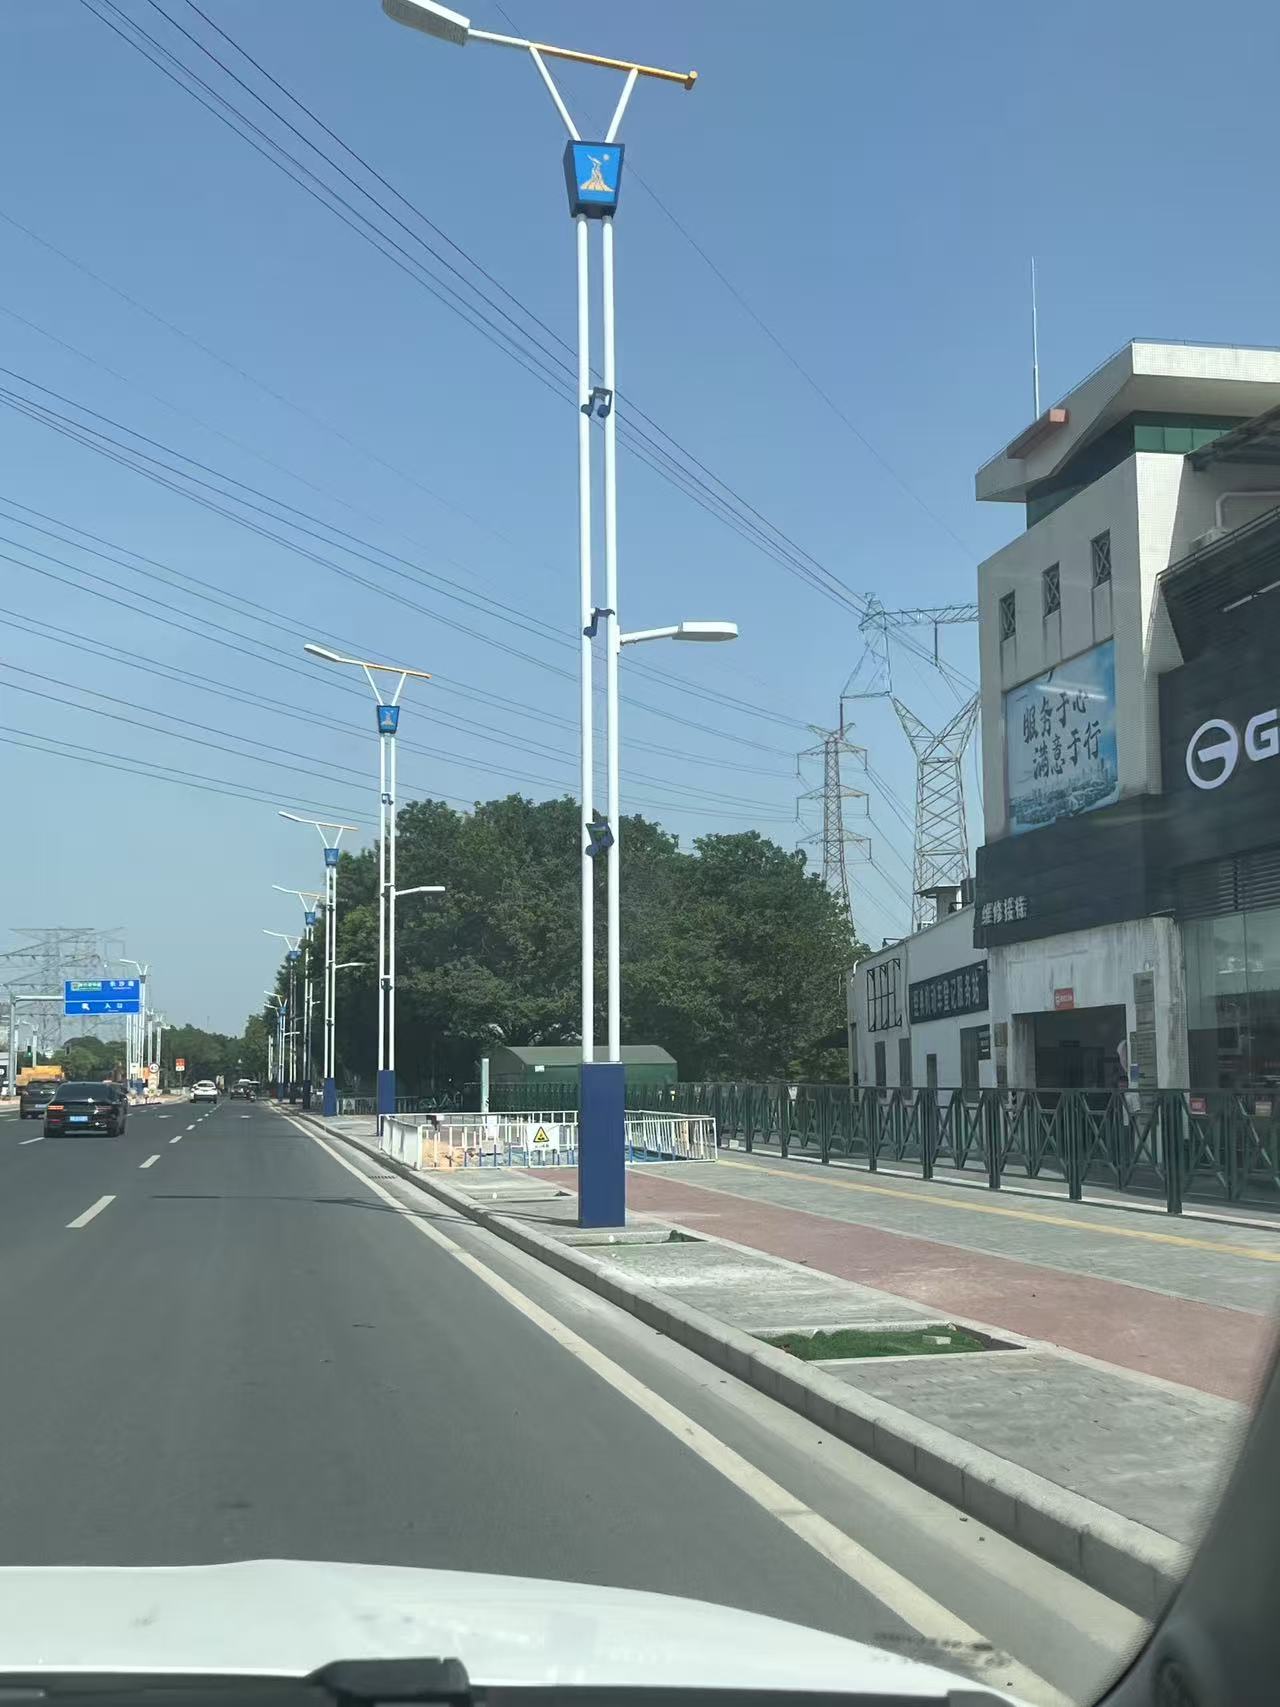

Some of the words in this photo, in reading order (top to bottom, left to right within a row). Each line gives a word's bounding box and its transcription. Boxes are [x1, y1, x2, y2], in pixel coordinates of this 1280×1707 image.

[1023, 689, 1089, 744] 服务于心
[1032, 720, 1102, 780] 满意于行
